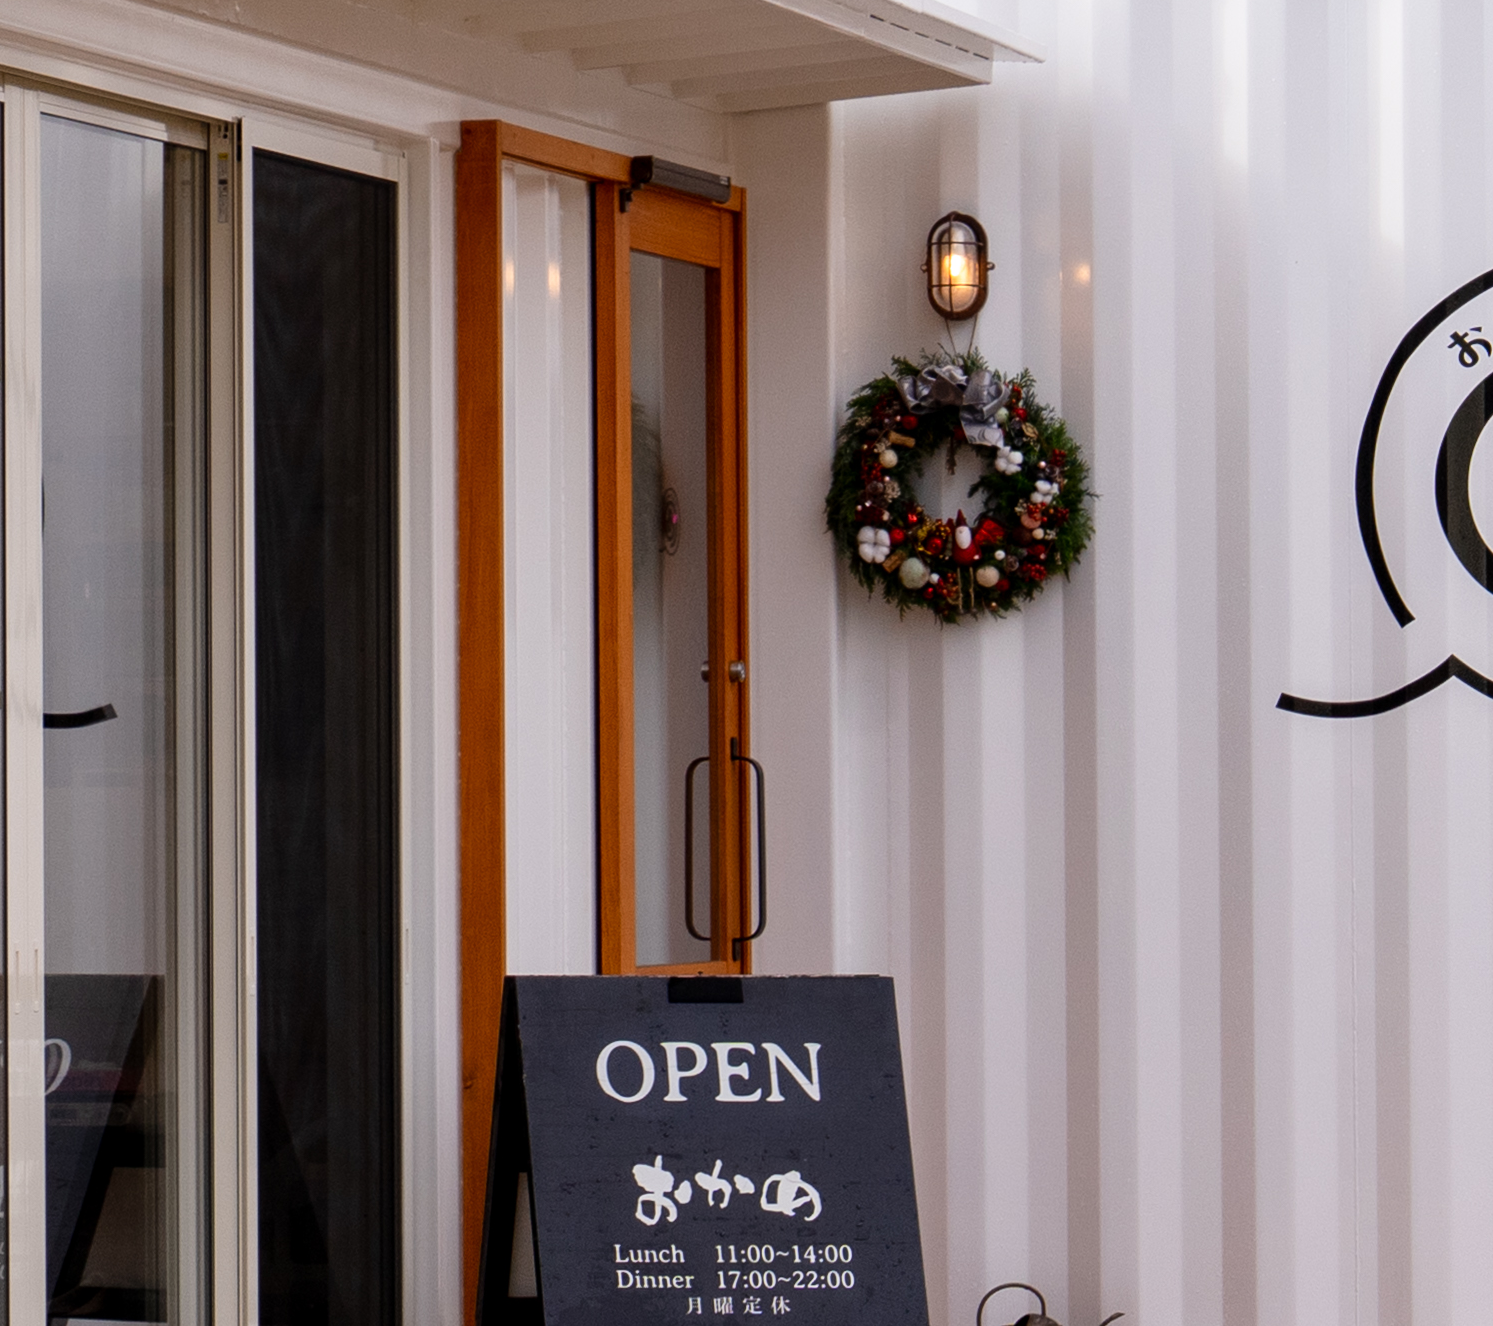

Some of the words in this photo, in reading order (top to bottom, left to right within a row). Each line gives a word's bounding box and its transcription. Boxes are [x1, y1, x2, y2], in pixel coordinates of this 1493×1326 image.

[596, 1040, 821, 1103] OPEN
[632, 1155, 822, 1226] おかめ
[614, 1244, 685, 1263] Lunch
[714, 1244, 852, 1264] 11:00~14:00
[616, 1270, 694, 1289] Dinner
[717, 1270, 855, 1289] 17:00~22:00
[686, 1296, 791, 1315] 月曜定休
